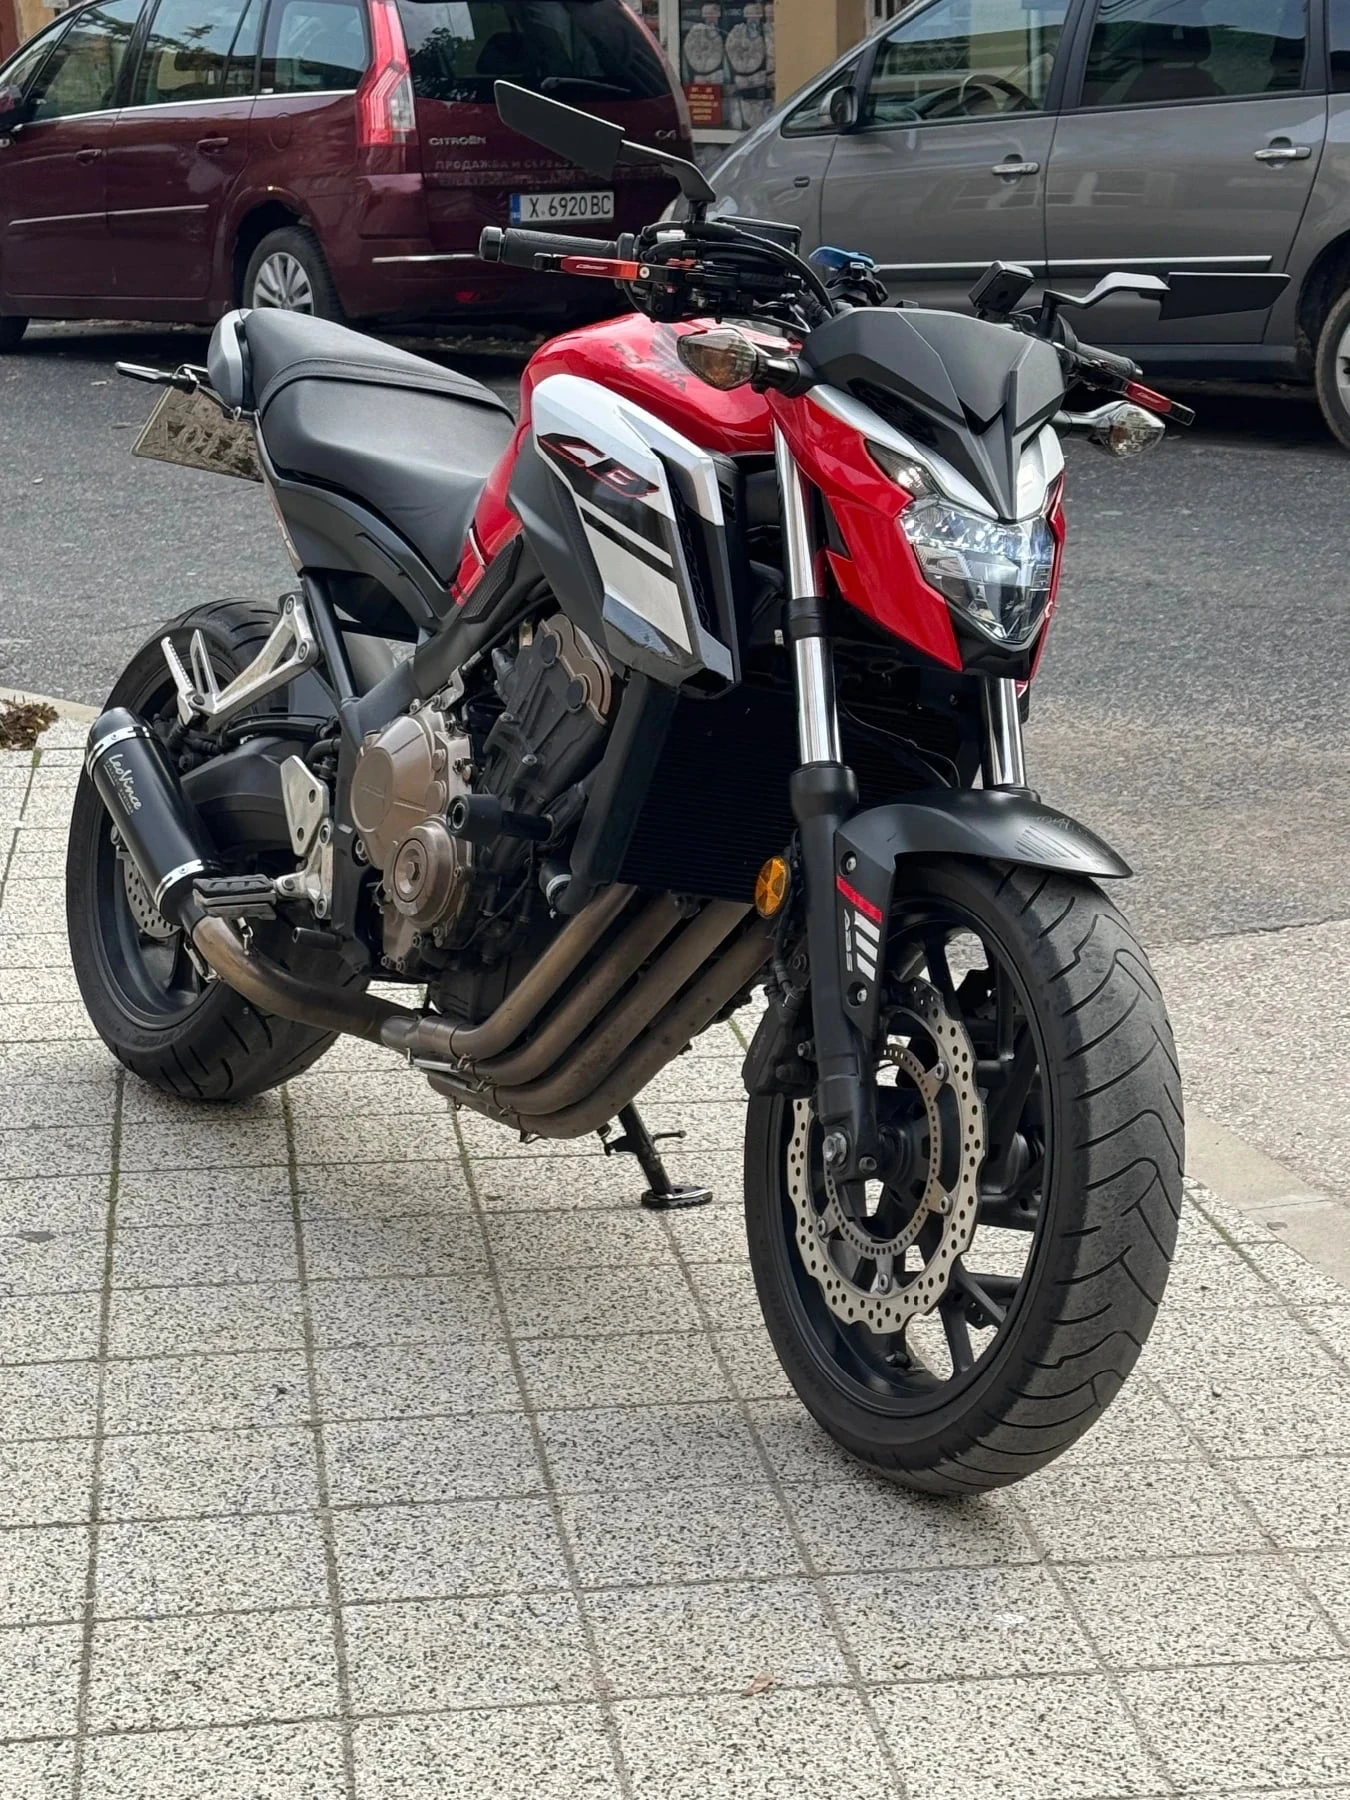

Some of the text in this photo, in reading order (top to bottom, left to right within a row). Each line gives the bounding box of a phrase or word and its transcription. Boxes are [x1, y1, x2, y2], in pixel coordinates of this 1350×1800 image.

[428, 134, 487, 146] CITROËN
[529, 197, 540, 218] X
[108, 753, 142, 811] LeoVince
